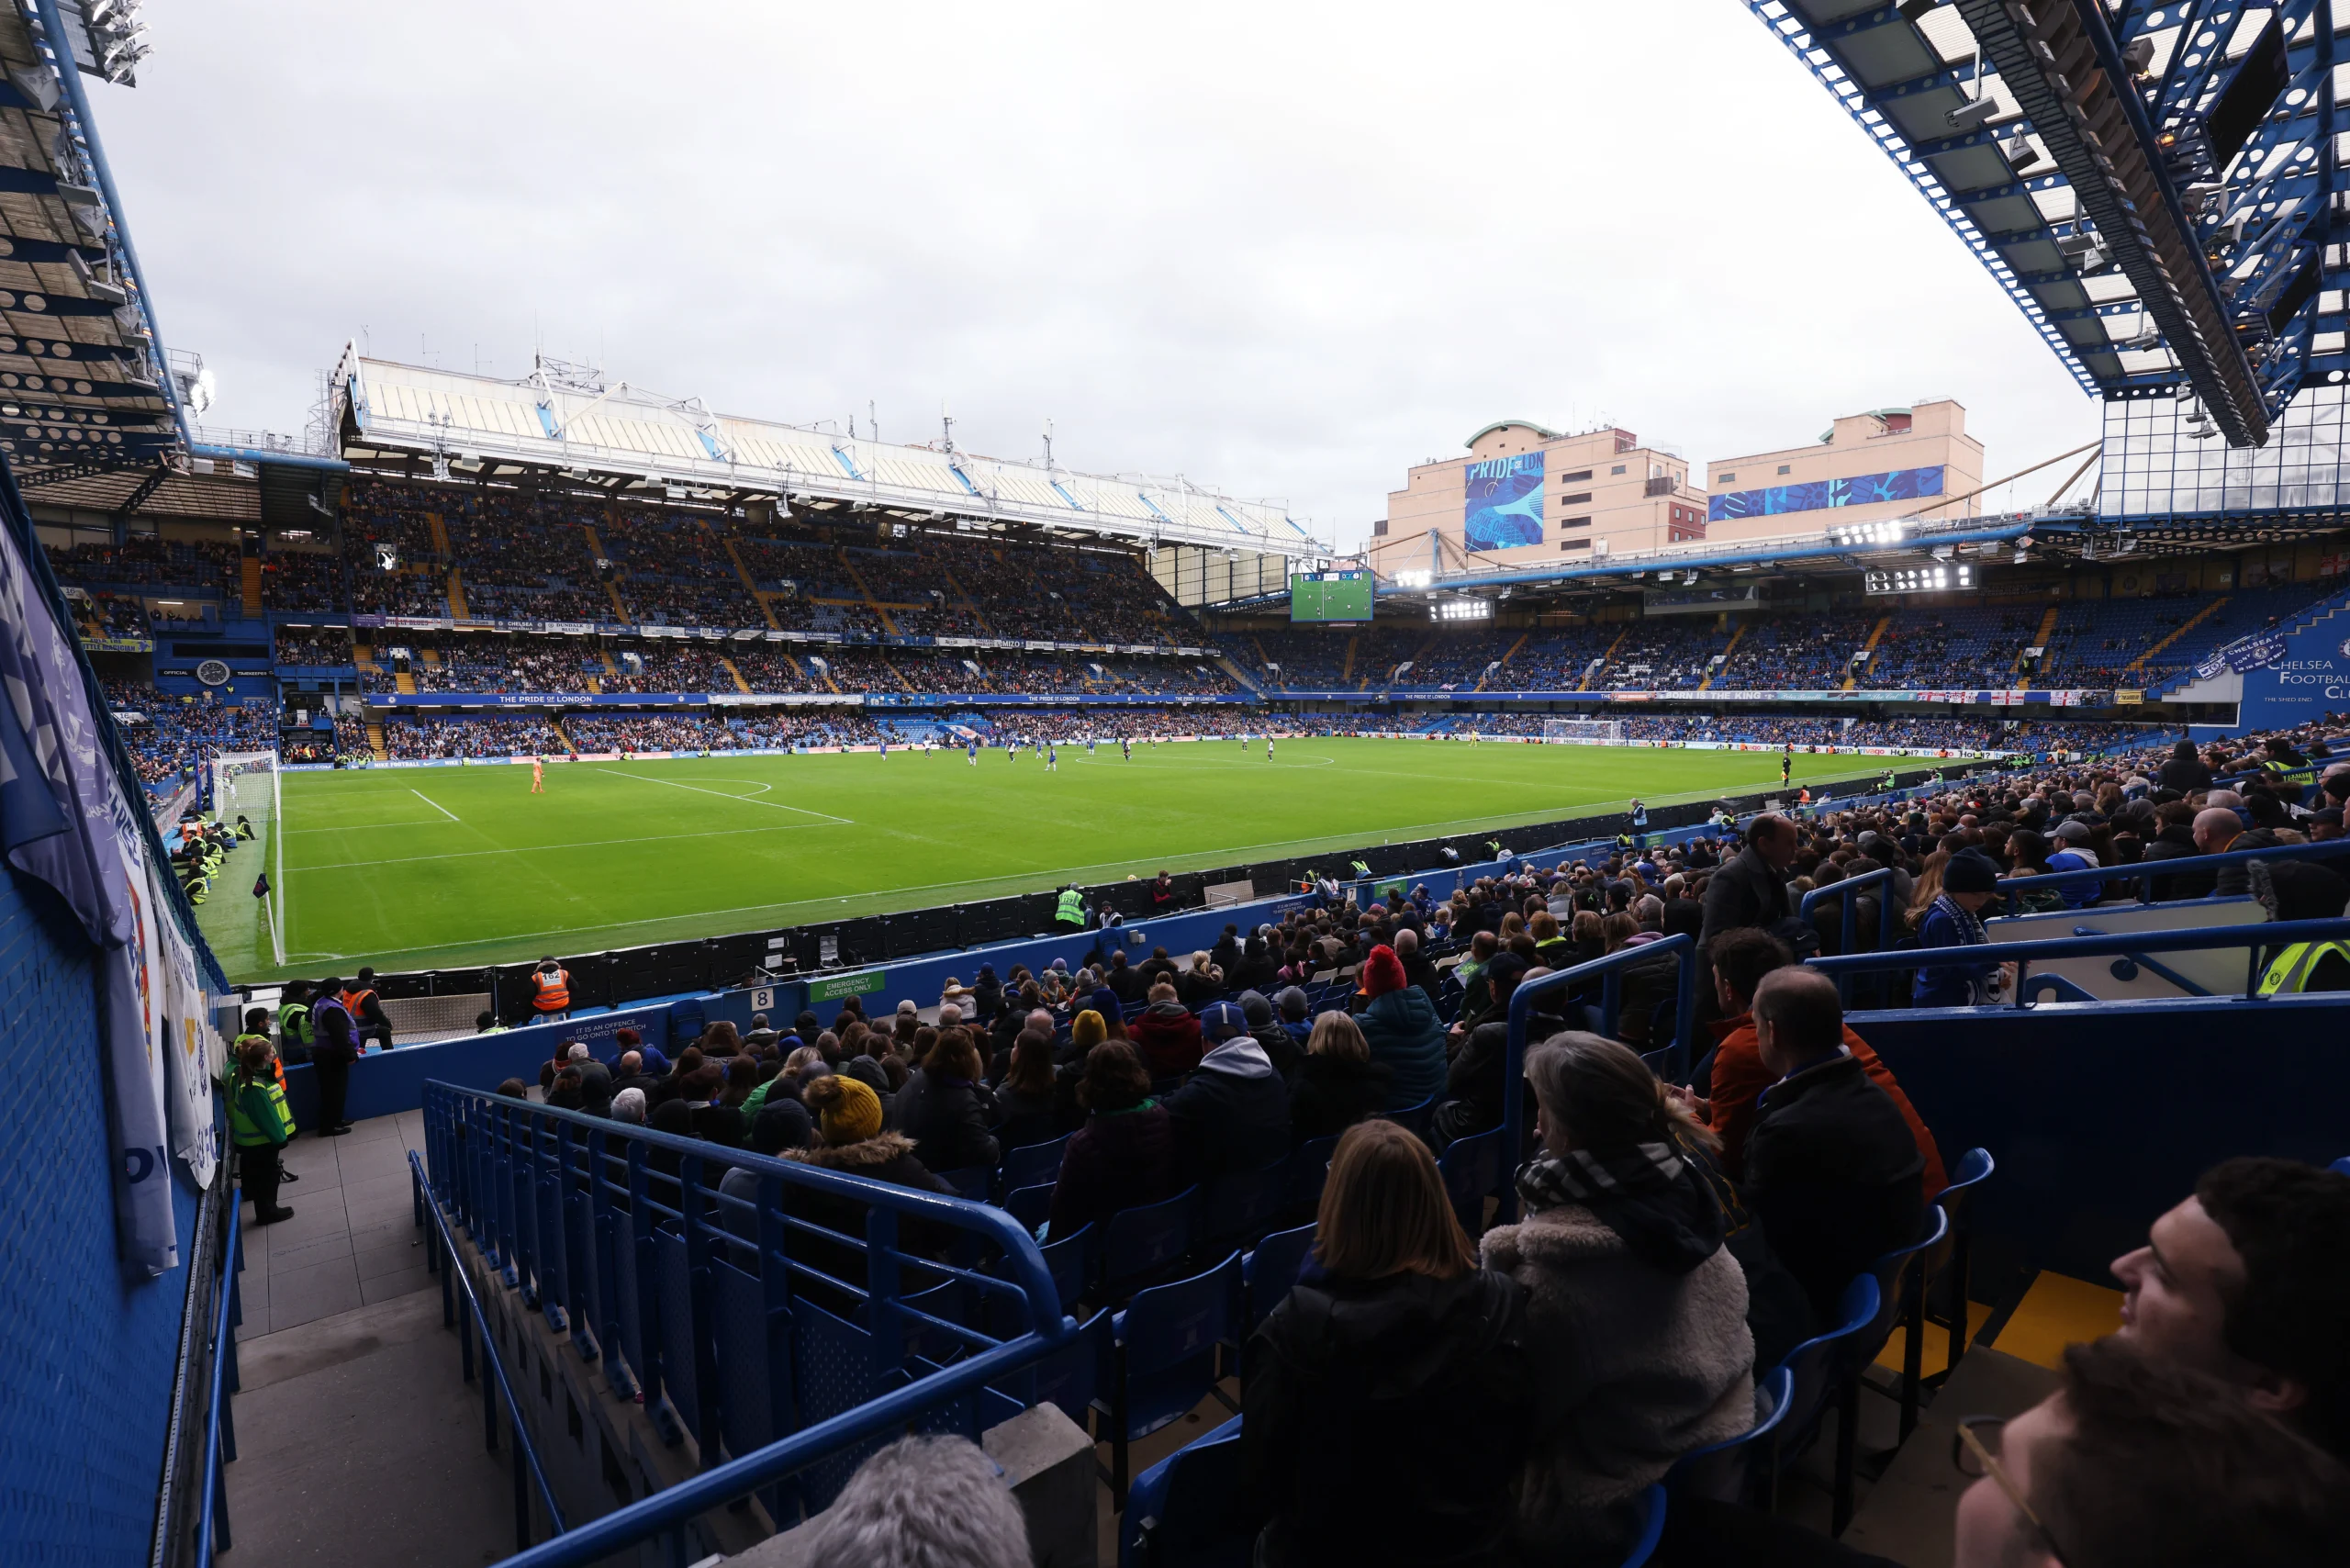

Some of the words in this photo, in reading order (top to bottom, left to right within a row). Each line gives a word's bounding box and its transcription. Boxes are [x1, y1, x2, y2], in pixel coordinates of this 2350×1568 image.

[1470, 457, 1516, 479] PRIDE
[1522, 451, 1544, 471] LDN
[1471, 513, 1491, 526] COME
[1493, 520, 1505, 533] ON
[1466, 522, 1477, 532] THE
[1478, 527, 1502, 543] BLUES
[2228, 637, 2272, 655] CHELSEA
[2234, 653, 2251, 666] TONY
[1349, 889, 1354, 898] 7
[824, 987, 853, 997] ACCESS
[854, 983, 872, 992] ONLY
[827, 977, 870, 990] EMERGENCY
[757, 991, 768, 1006] 8
[604, 1019, 636, 1029] OFFENCE
[590, 1030, 610, 1038] ONTO
